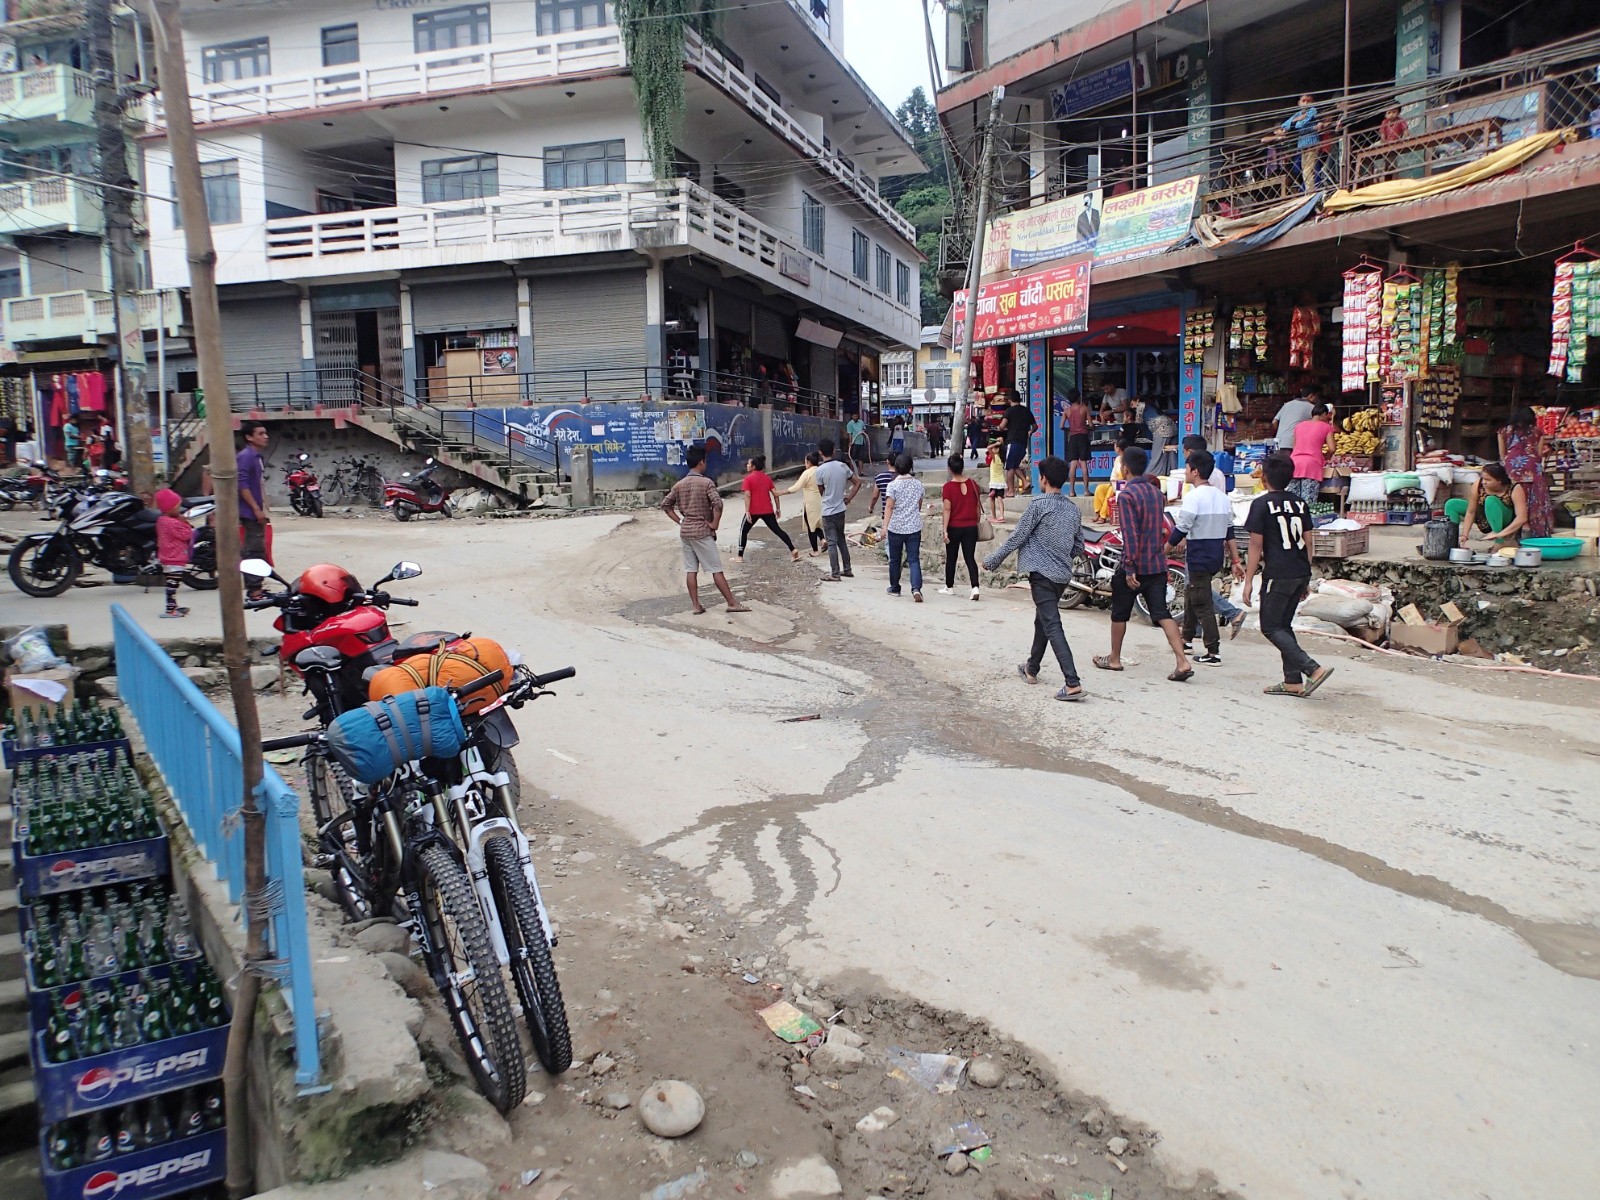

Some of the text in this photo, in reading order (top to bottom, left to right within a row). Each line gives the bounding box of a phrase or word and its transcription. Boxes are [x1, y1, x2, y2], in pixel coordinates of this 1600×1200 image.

[999, 291, 1018, 315] सुन
[1046, 278, 1076, 301] पसल
[1267, 500, 1305, 514] LAY
[109, 1047, 209, 1089] PEPSI
[113, 1148, 212, 1192] PEPSI
